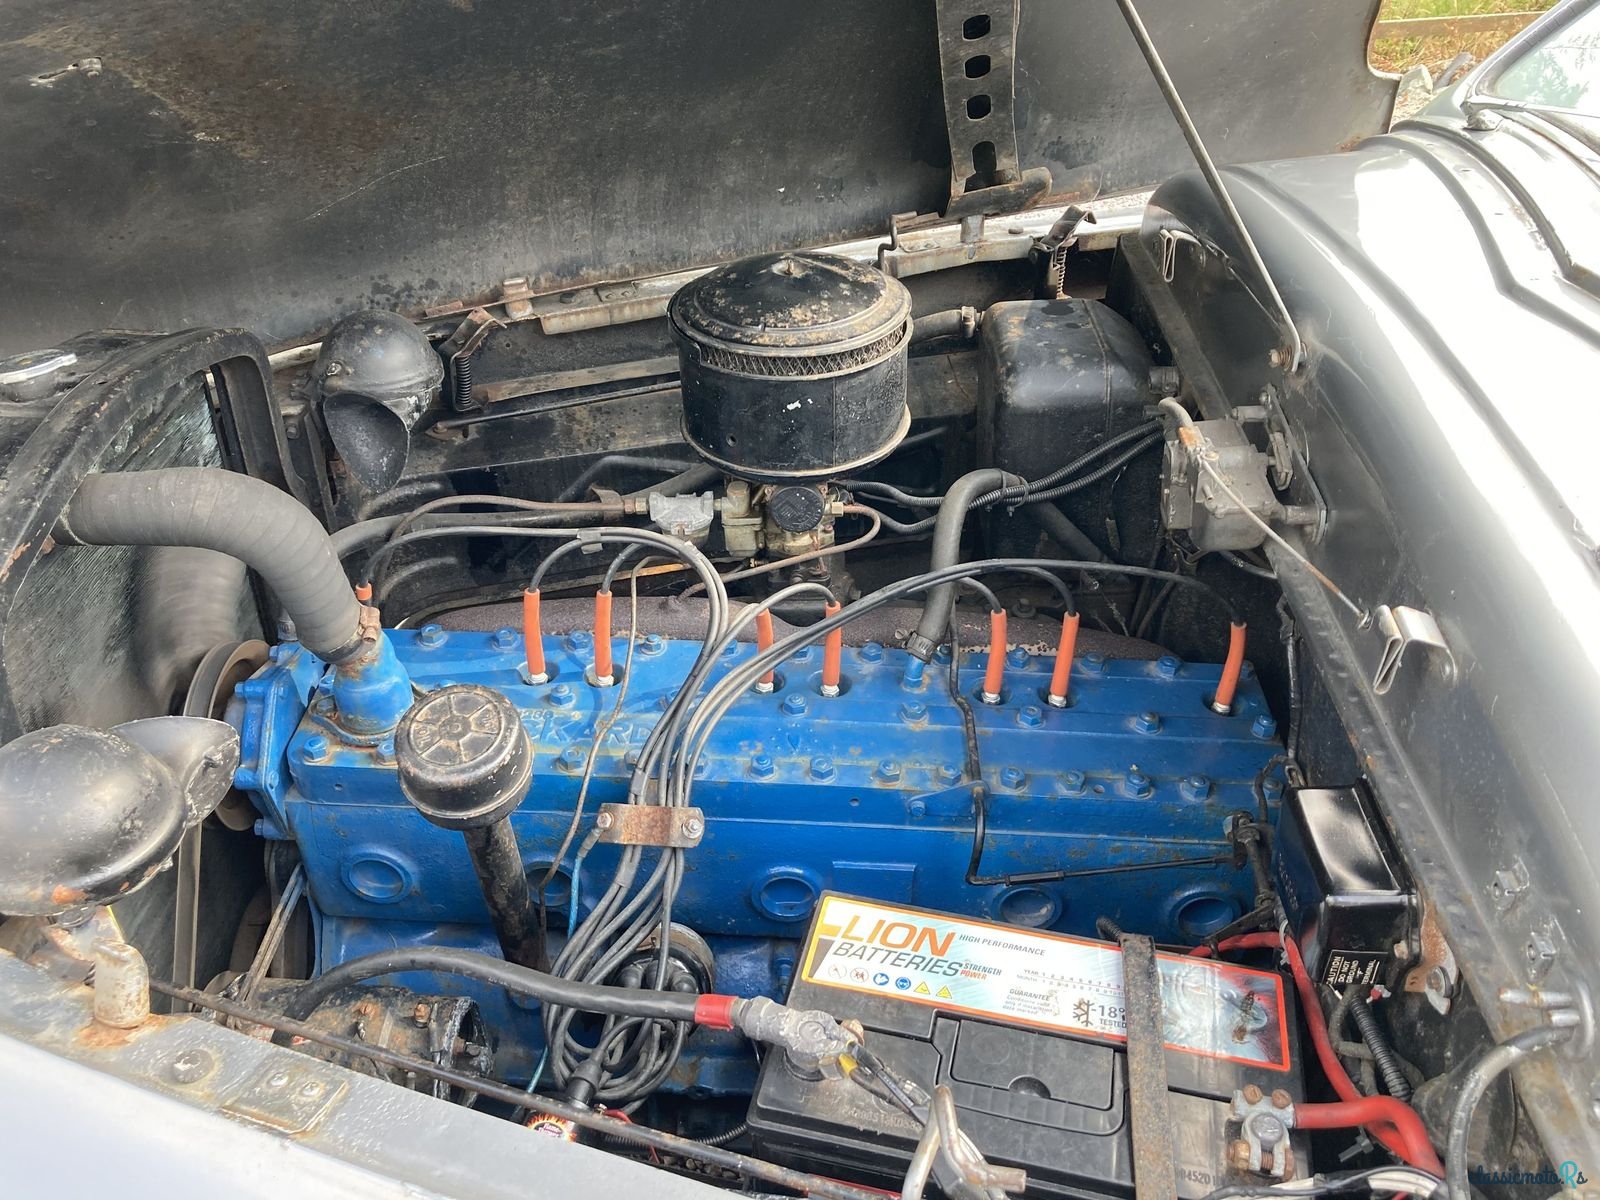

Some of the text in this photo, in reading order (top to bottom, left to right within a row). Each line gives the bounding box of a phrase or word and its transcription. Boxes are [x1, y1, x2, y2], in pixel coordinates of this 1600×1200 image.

[841, 915, 957, 957] LION
[958, 933, 1046, 957] HIGH PERFORMANCE
[833, 941, 964, 977] BATTERIES
[1341, 960, 1351, 973] NOT
[960, 969, 988, 981] POWER
[963, 962, 1003, 976] STRENGTH
[1345, 960, 1359, 984] GROUND
[1361, 959, 1376, 985] TERMINAL
[1009, 988, 1050, 1002] GUARANTEE
[1099, 1018, 1127, 1029] TESTED
